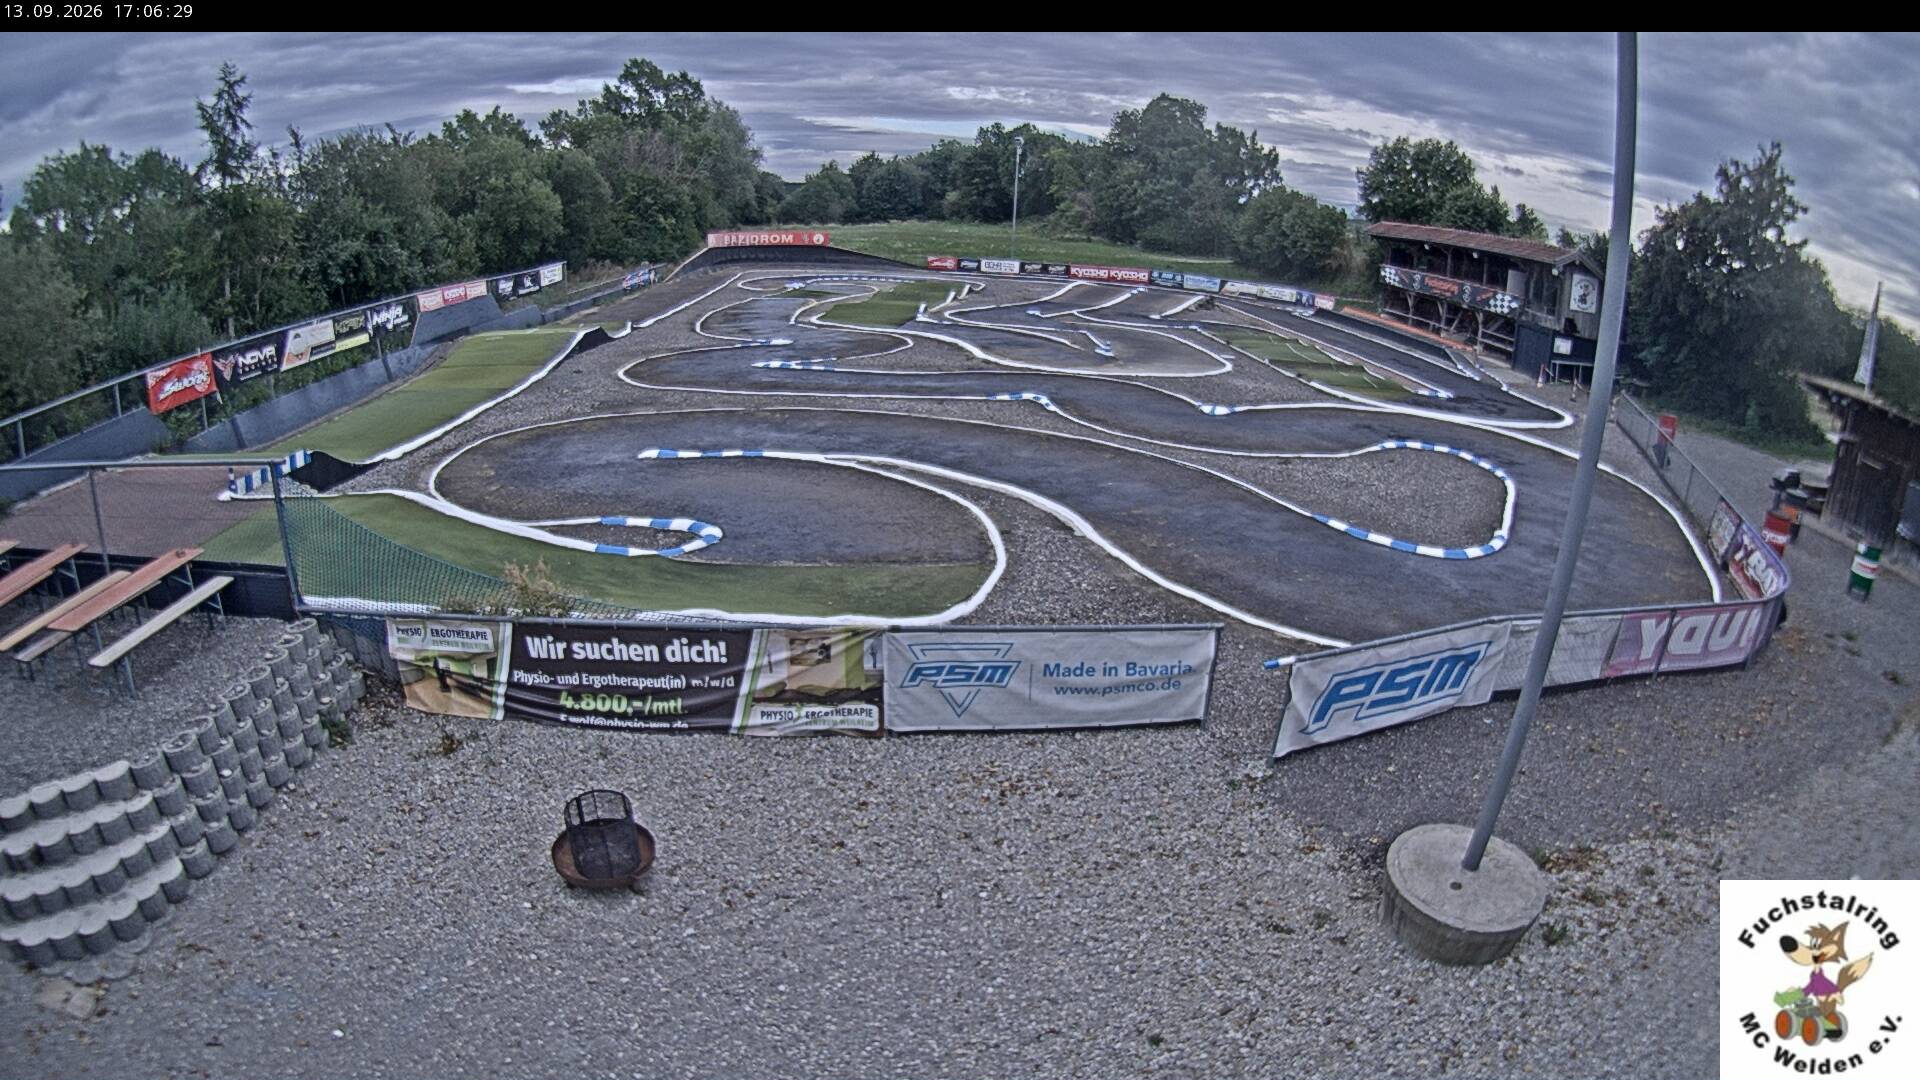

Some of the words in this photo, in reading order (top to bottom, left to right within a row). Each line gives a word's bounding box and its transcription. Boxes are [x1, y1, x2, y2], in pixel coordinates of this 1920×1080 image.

[238, 345, 277, 367] NOVA
[396, 626, 422, 638] PHYSIO
[430, 628, 488, 641] ERGOTHERAPIE
[525, 635, 567, 660] Wir
[571, 638, 660, 662] suchen
[665, 637, 728, 664] dich!
[513, 669, 555, 687] Physio-
[557, 672, 580, 686] und
[582, 673, 686, 691] Ergotherapeut(in)
[691, 675, 735, 688] m/w/d
[905, 662, 1016, 687] PSM
[1043, 661, 1097, 678] Made
[1102, 662, 1119, 677] in
[1125, 660, 1193, 677] Bavaria
[1053, 678, 1182, 697] www.psmco.de
[1310, 648, 1484, 725] PSM
[760, 710, 794, 721] PHYSIO
